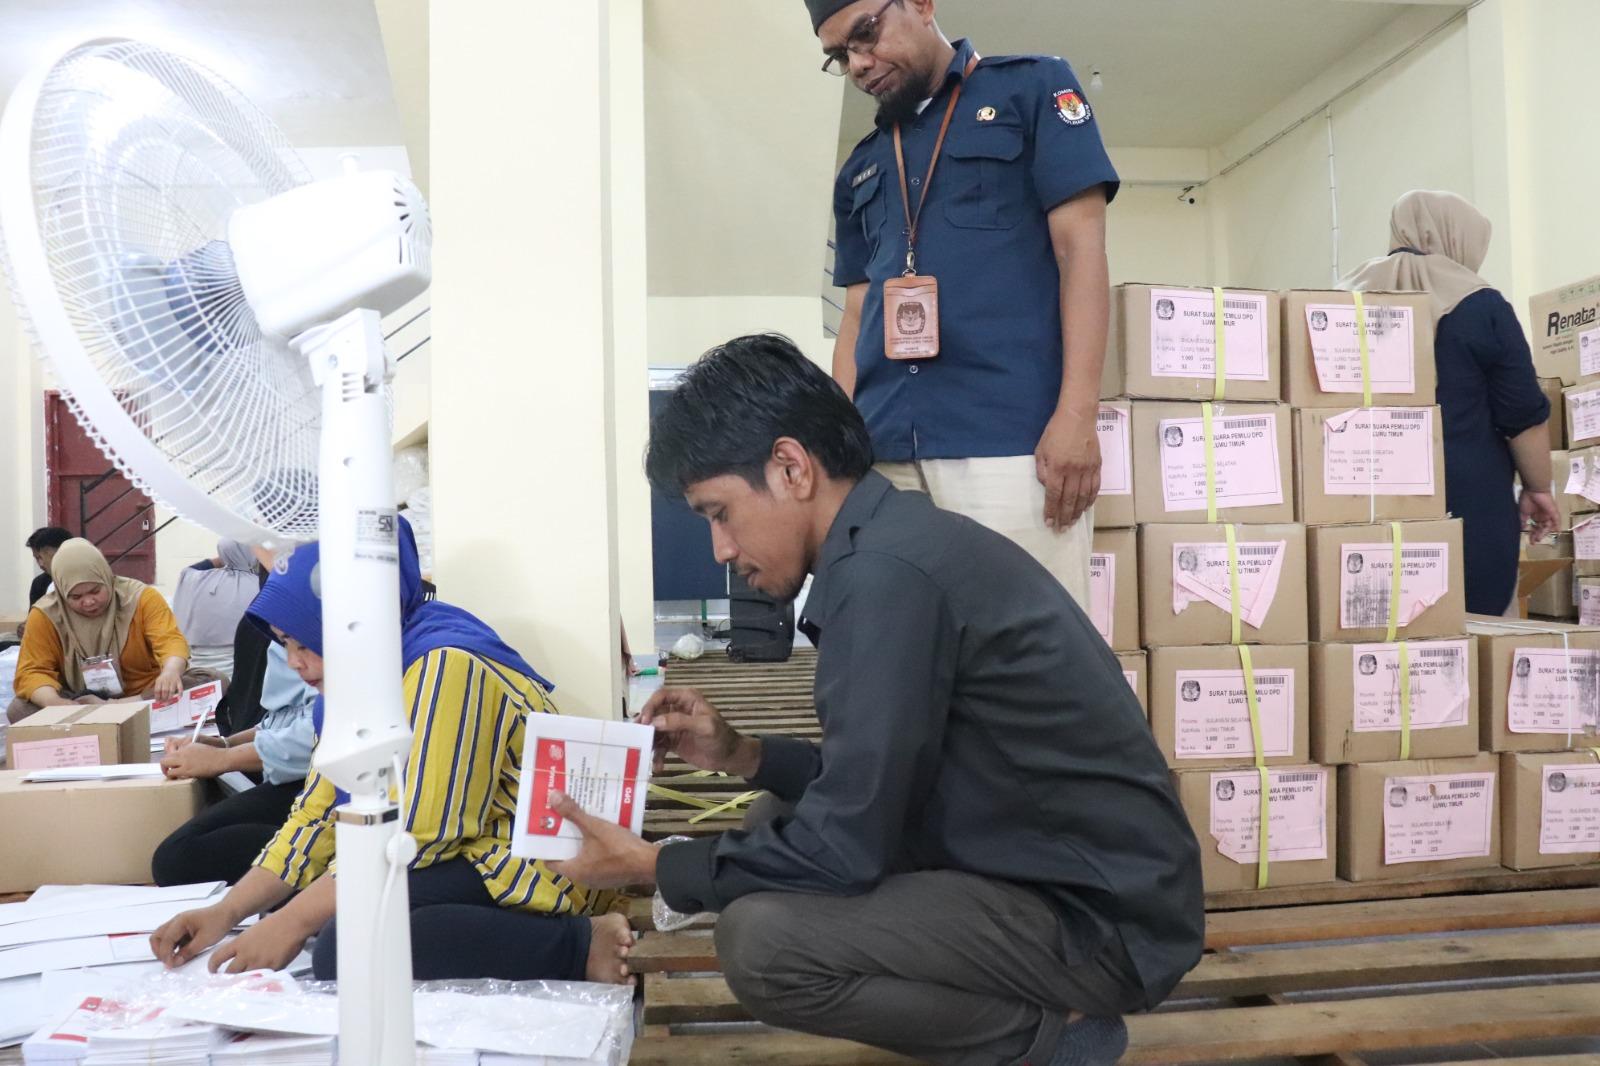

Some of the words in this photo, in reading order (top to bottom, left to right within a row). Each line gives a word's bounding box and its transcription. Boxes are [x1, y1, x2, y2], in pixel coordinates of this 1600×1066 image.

[1547, 307, 1596, 336] Renata
[1231, 432, 1251, 440] PEMILU
[1206, 560, 1226, 568] SURAT
[1209, 689, 1227, 697] SURAT
[1228, 689, 1247, 697] SUARA
[1269, 688, 1281, 696] DPD
[623, 786, 634, 805] DPD
